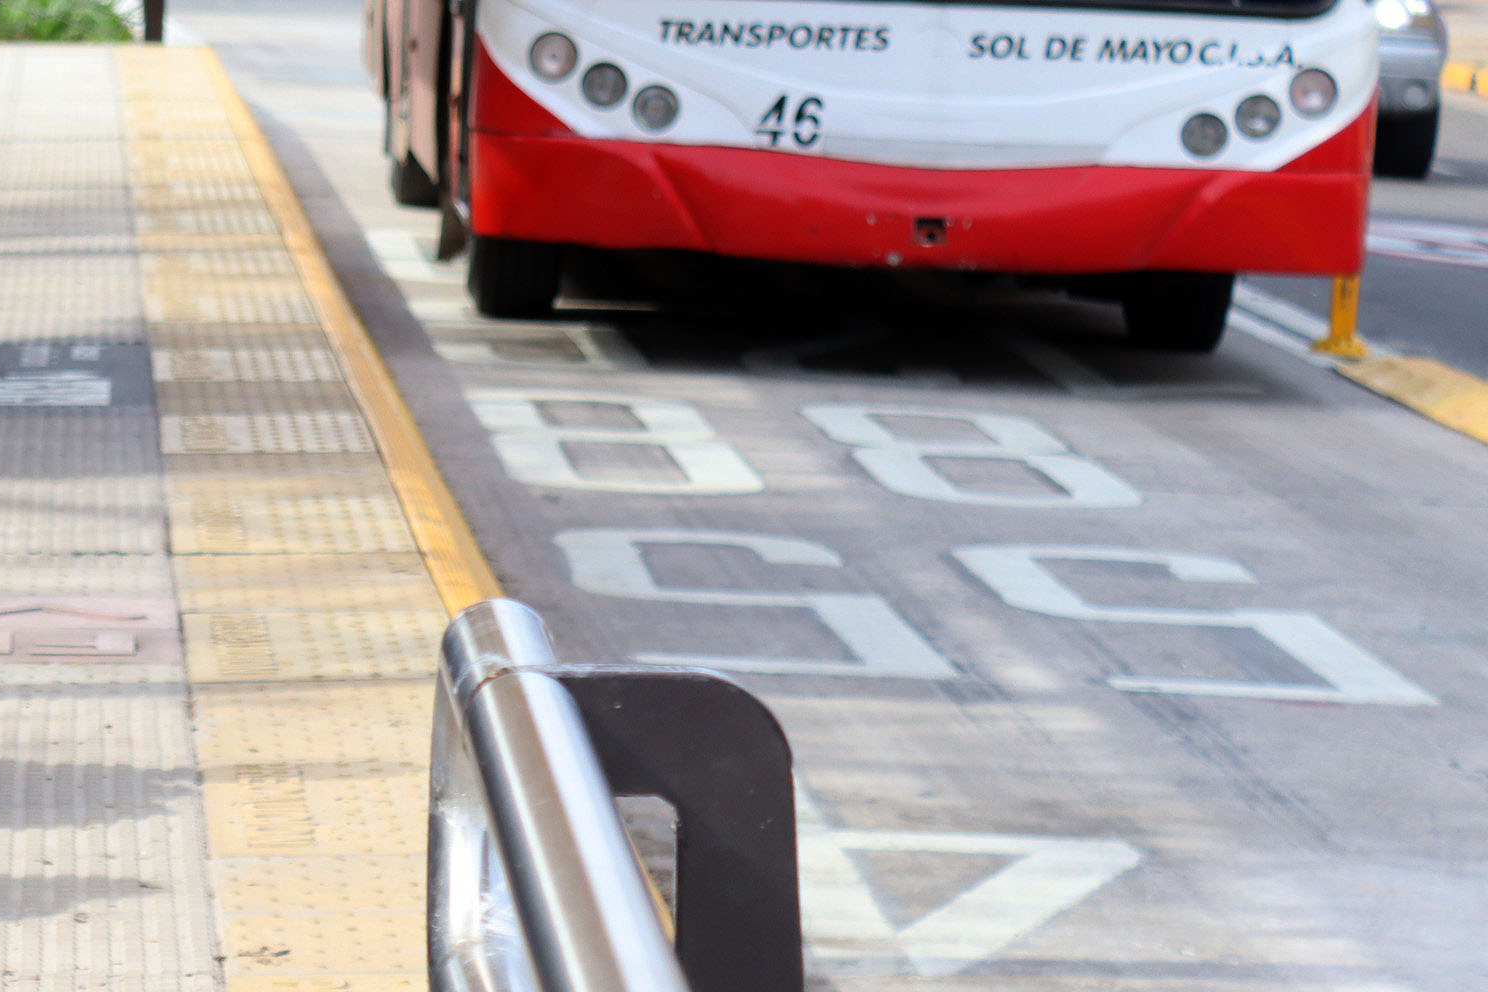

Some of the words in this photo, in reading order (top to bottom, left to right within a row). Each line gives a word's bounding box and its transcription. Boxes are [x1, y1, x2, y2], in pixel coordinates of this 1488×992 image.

[659, 19, 891, 52] TRANSPORTES
[969, 33, 1032, 60] SOL
[1044, 36, 1089, 61] DE
[1098, 38, 1193, 65] MAYO
[756, 93, 825, 147] 46
